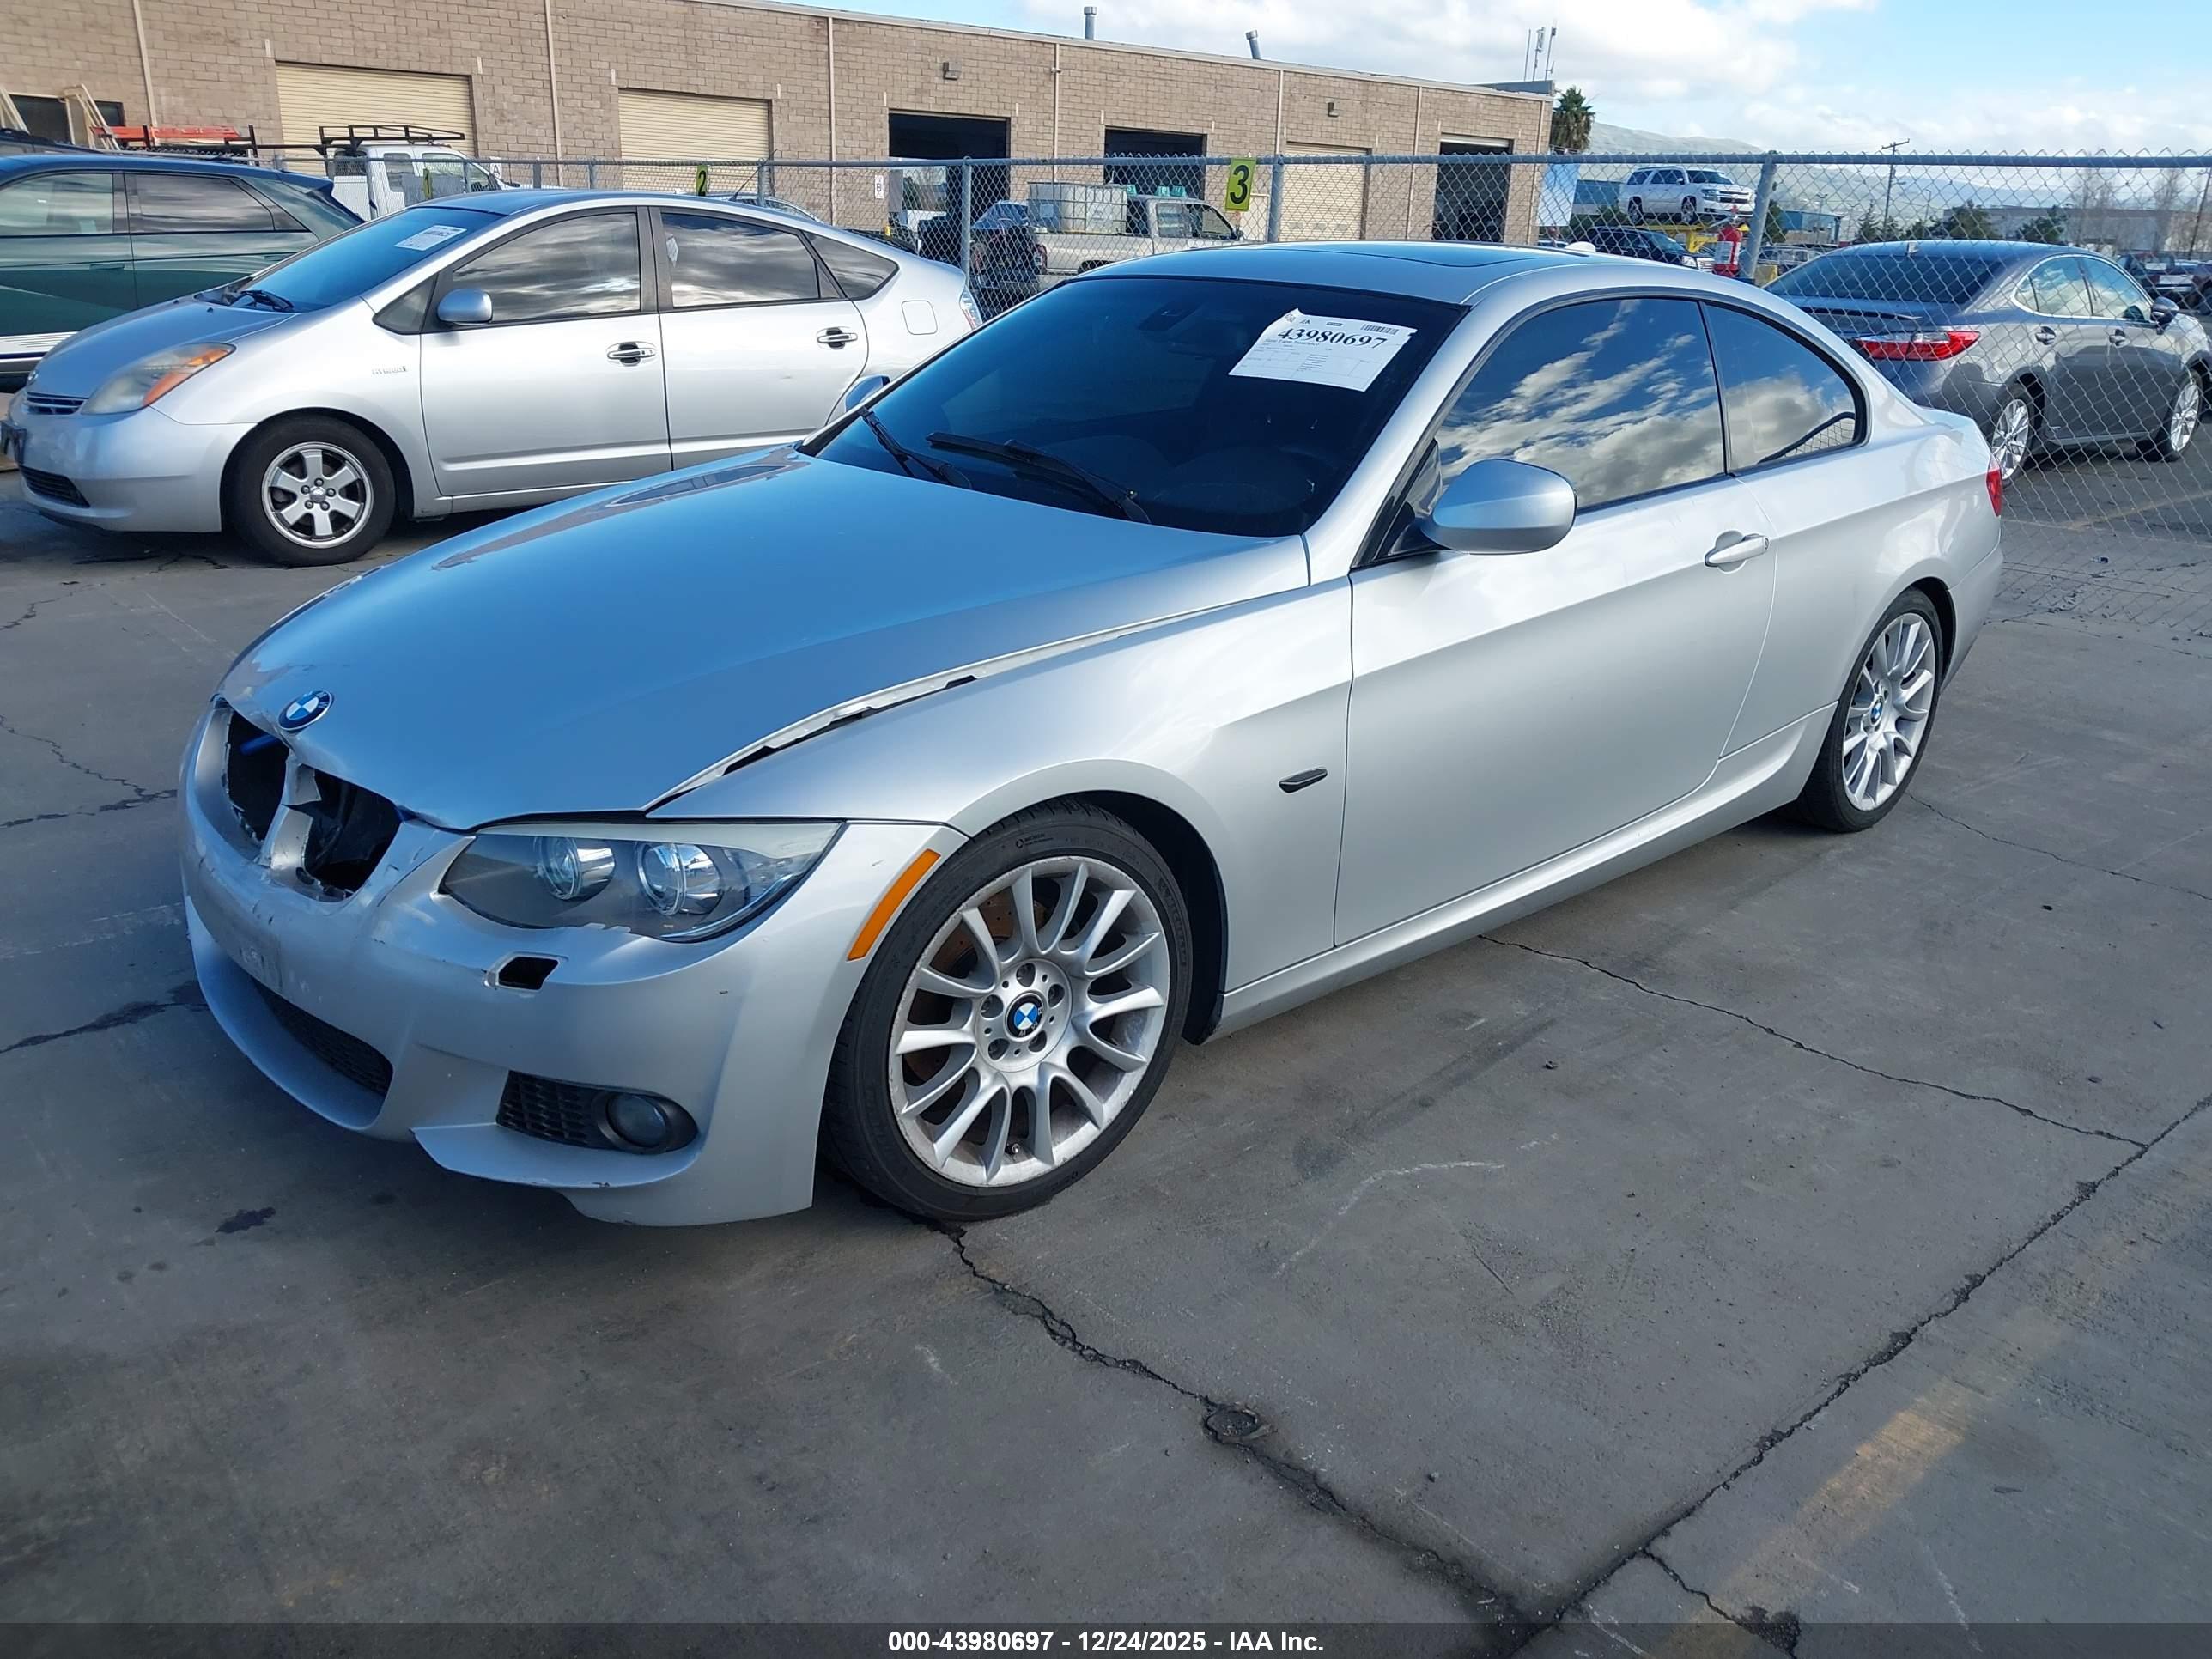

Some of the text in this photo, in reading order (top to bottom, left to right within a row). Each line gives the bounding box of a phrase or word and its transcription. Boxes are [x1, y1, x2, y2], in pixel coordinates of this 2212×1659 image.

[698, 170, 706, 197] 2
[1230, 165, 1249, 204] 3
[1278, 328, 1388, 349] 43980697
